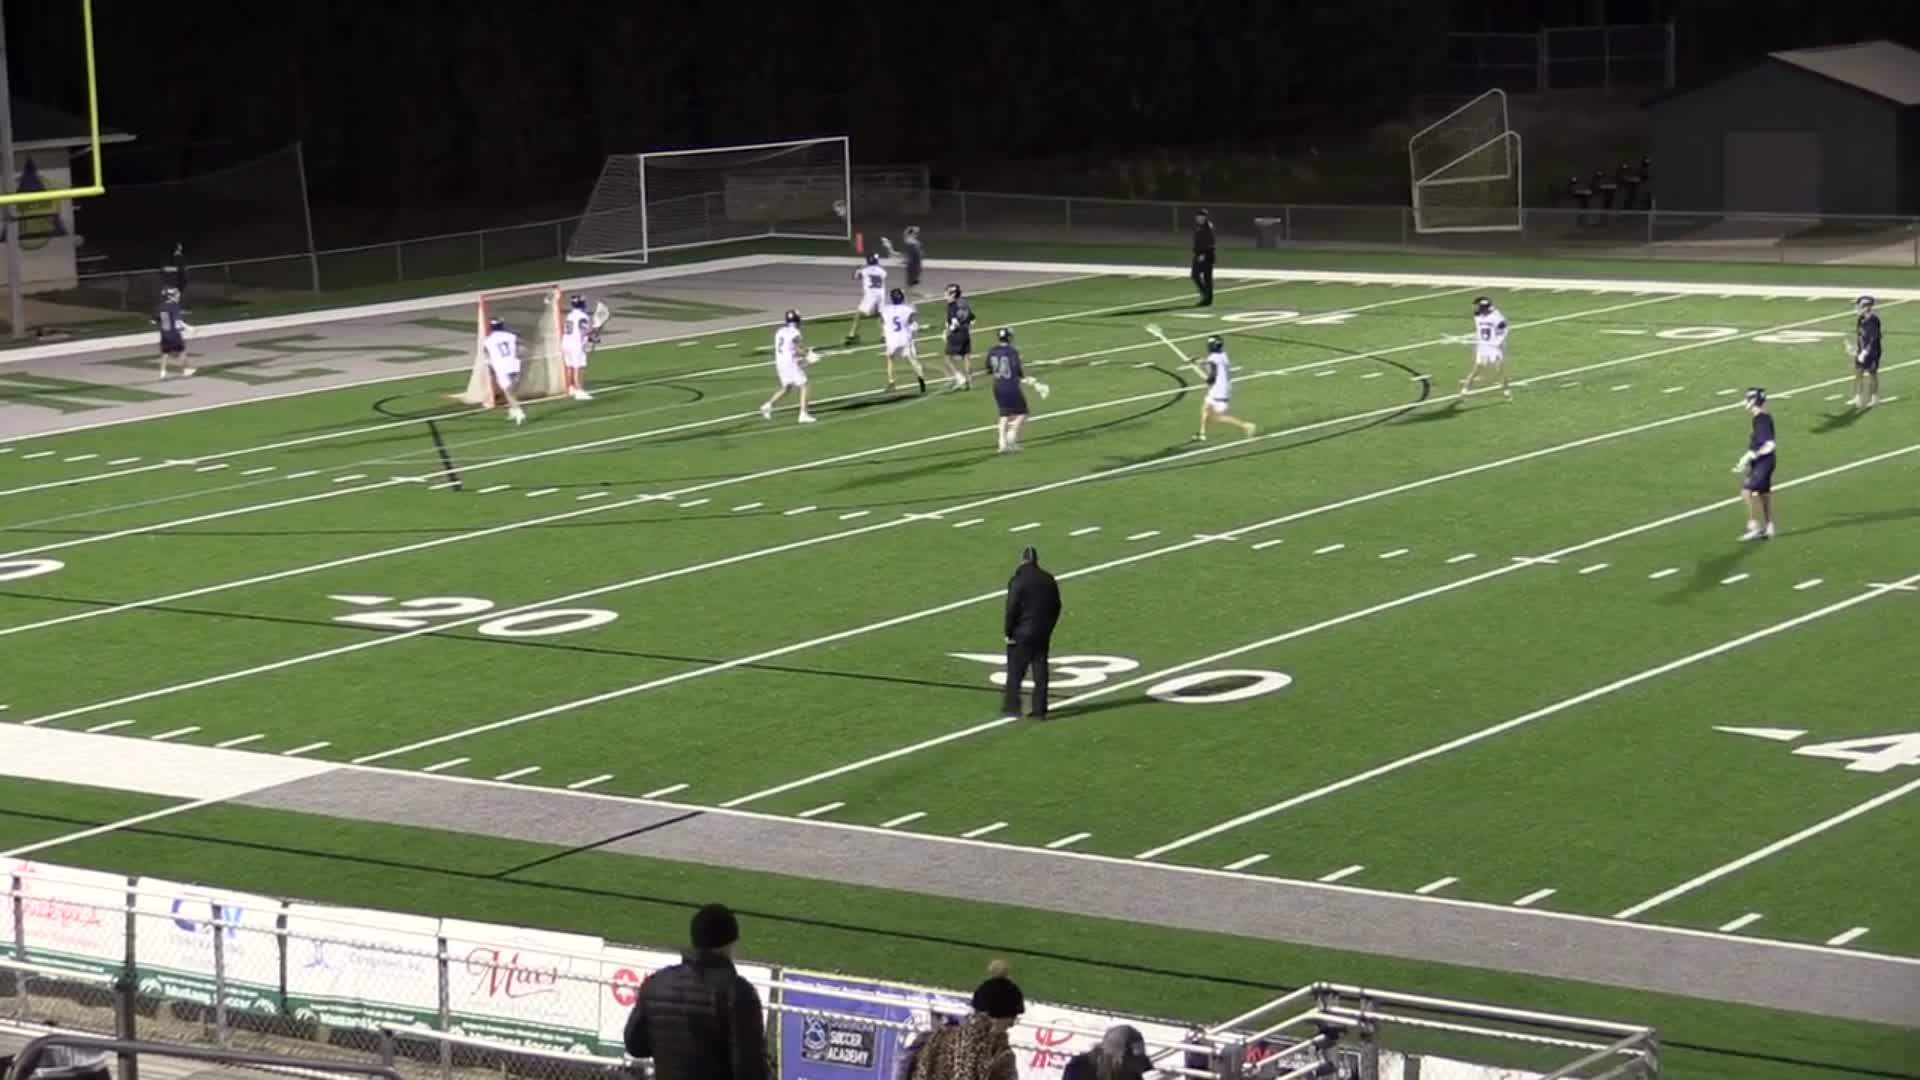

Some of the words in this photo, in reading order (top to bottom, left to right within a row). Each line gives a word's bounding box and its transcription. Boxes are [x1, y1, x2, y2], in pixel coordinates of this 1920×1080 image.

[892, 316, 902, 332] 5
[332, 596, 619, 637] 20
[989, 655, 1293, 703] 30
[830, 1030, 863, 1048] SOCCER
[827, 1047, 869, 1065] ACADEMY
